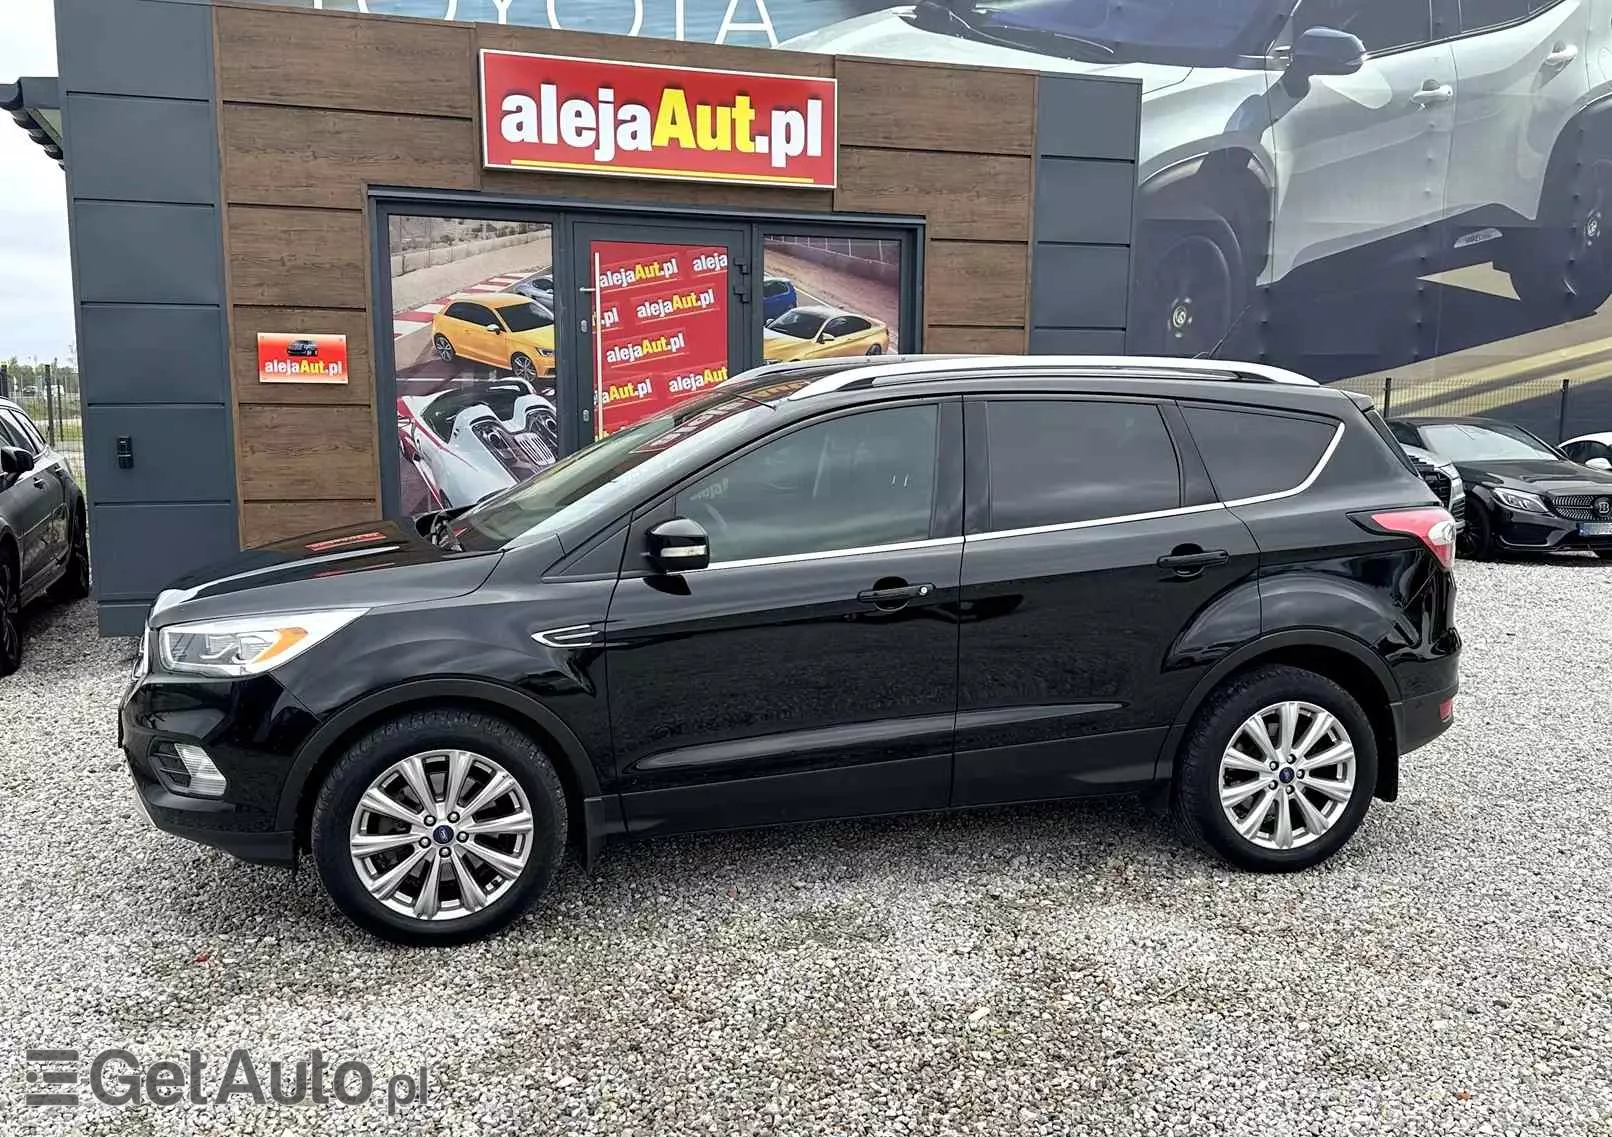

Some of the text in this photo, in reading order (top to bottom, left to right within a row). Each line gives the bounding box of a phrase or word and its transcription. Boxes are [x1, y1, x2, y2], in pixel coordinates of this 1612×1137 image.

[501, 83, 823, 168] alejaAut.pl
[600, 258, 678, 288] alejaAut.pl
[636, 288, 715, 318] alejaAut.pl
[606, 332, 685, 362] alejaAut.pl
[264, 359, 343, 376] alejaAut.pl
[668, 366, 728, 393] alejaAut
